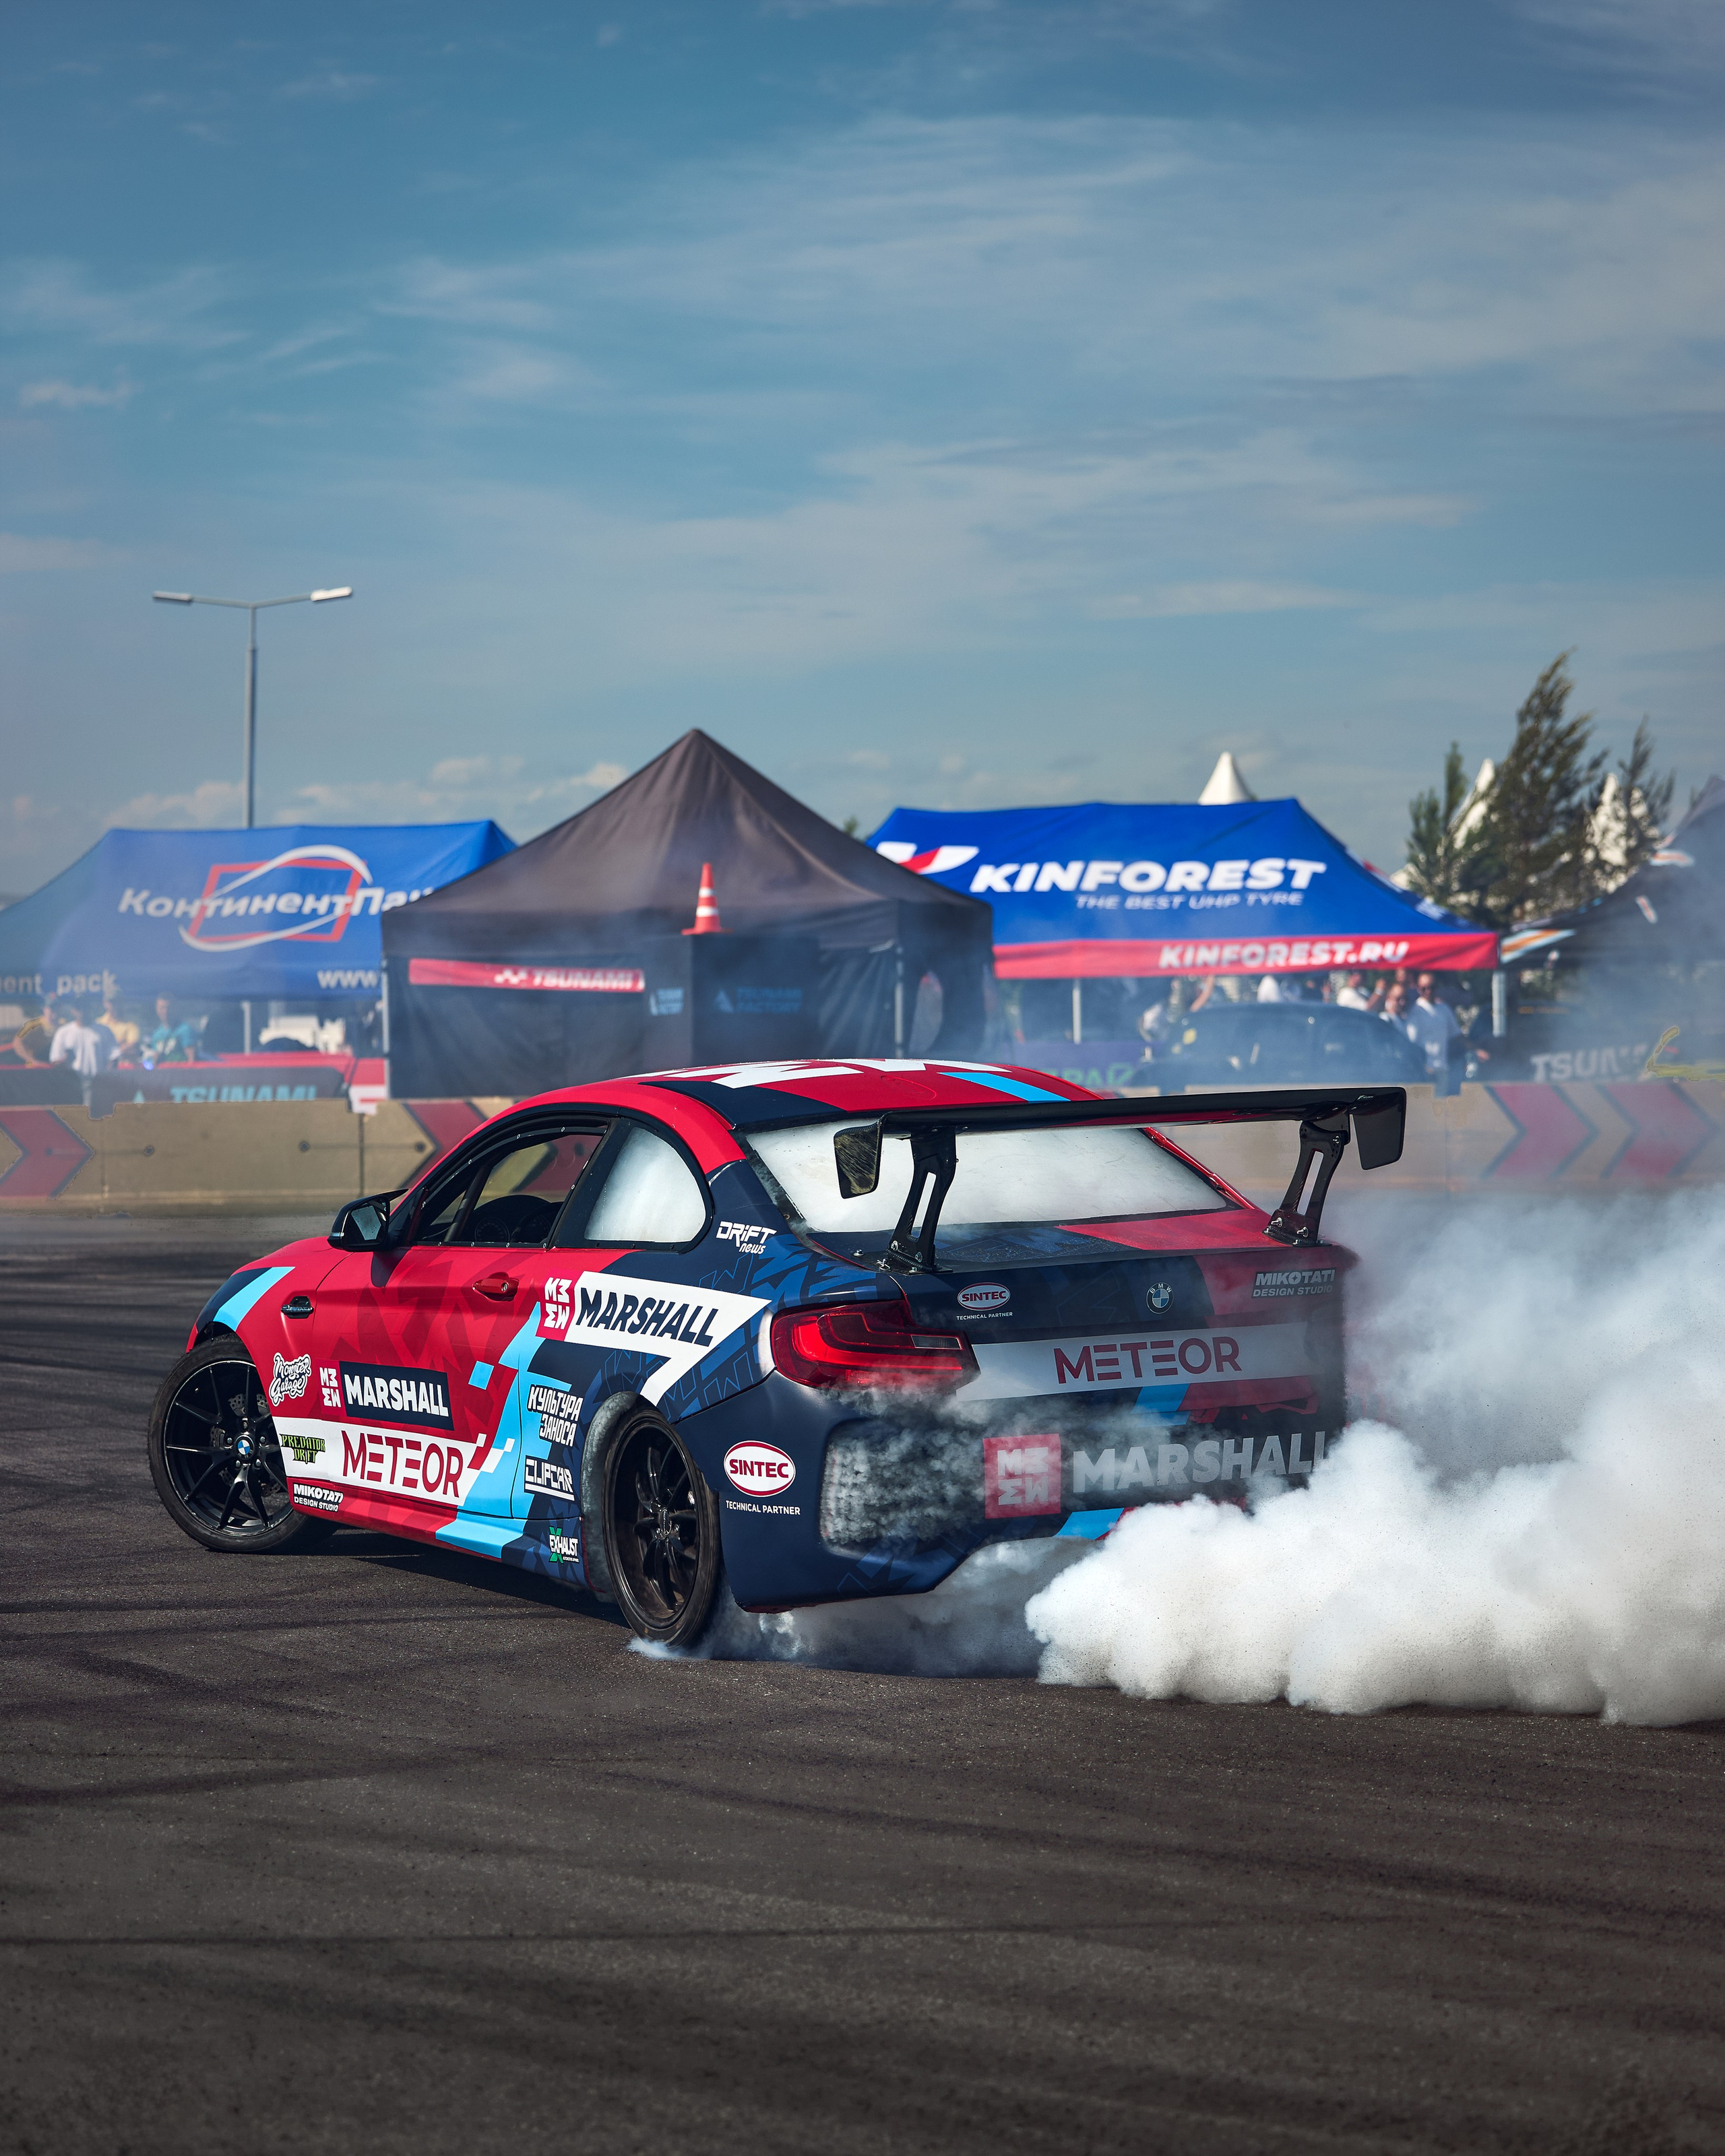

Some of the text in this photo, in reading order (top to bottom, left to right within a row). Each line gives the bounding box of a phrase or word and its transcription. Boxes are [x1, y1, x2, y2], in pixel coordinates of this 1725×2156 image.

[970, 858, 1327, 893] KINFOREST
[1076, 891, 1305, 910] THE BEST UHP TYRE
[1159, 941, 1410, 969] KINFOREST.RU
[0, 973, 43, 995] ent
[533, 969, 633, 990] TSUNAMI
[170, 1085, 317, 1103] TSUNAMI
[739, 1243, 766, 1255] news
[1255, 1269, 1335, 1286] MIKOTATI
[962, 1291, 1006, 1302] SINTEC
[1150, 1283, 1172, 1294] BMW
[1253, 1285, 1333, 1297] DESIGN STUDIO
[575, 1287, 719, 1347] MARSHALL
[1054, 1336, 1243, 1384] METEOR
[344, 1374, 449, 1417] MARSHALL
[528, 1386, 584, 1422] КУЛЬТУРА
[540, 1414, 577, 1447] ЗАНОСА
[282, 1435, 325, 1451] PREDATOR
[294, 1449, 317, 1463] DRIFT
[341, 1430, 463, 1498] METEOR
[729, 1459, 789, 1478] SINTEC
[294, 1496, 339, 1512] DESIGN STUDIO
[726, 1500, 801, 1515] TECHNICAL PARTNER
[549, 1534, 578, 1556] EXHAUST
